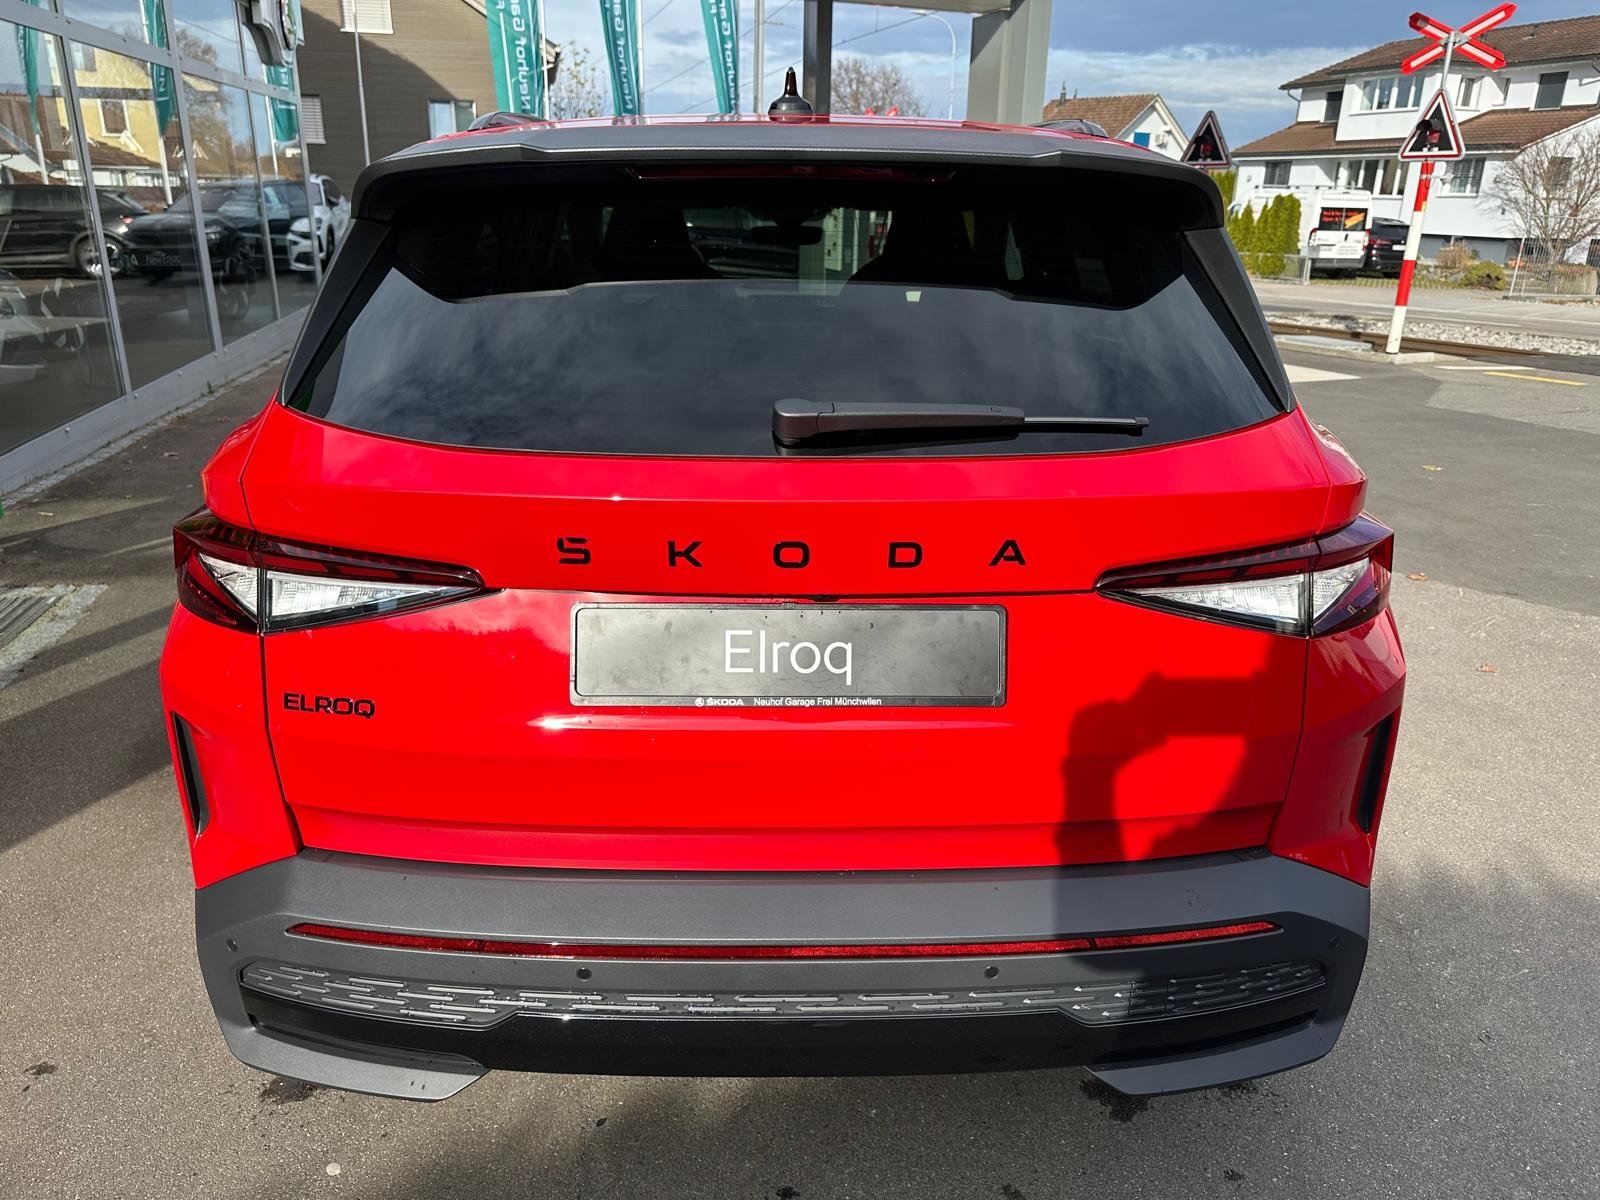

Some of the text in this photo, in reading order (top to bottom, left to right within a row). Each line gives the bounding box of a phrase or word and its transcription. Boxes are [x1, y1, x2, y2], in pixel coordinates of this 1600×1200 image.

[724, 629, 853, 686] Elroq
[283, 692, 376, 719] ELROQ
[706, 697, 882, 708] ŠKODA Neuhof Garage Frei Münchwilen
